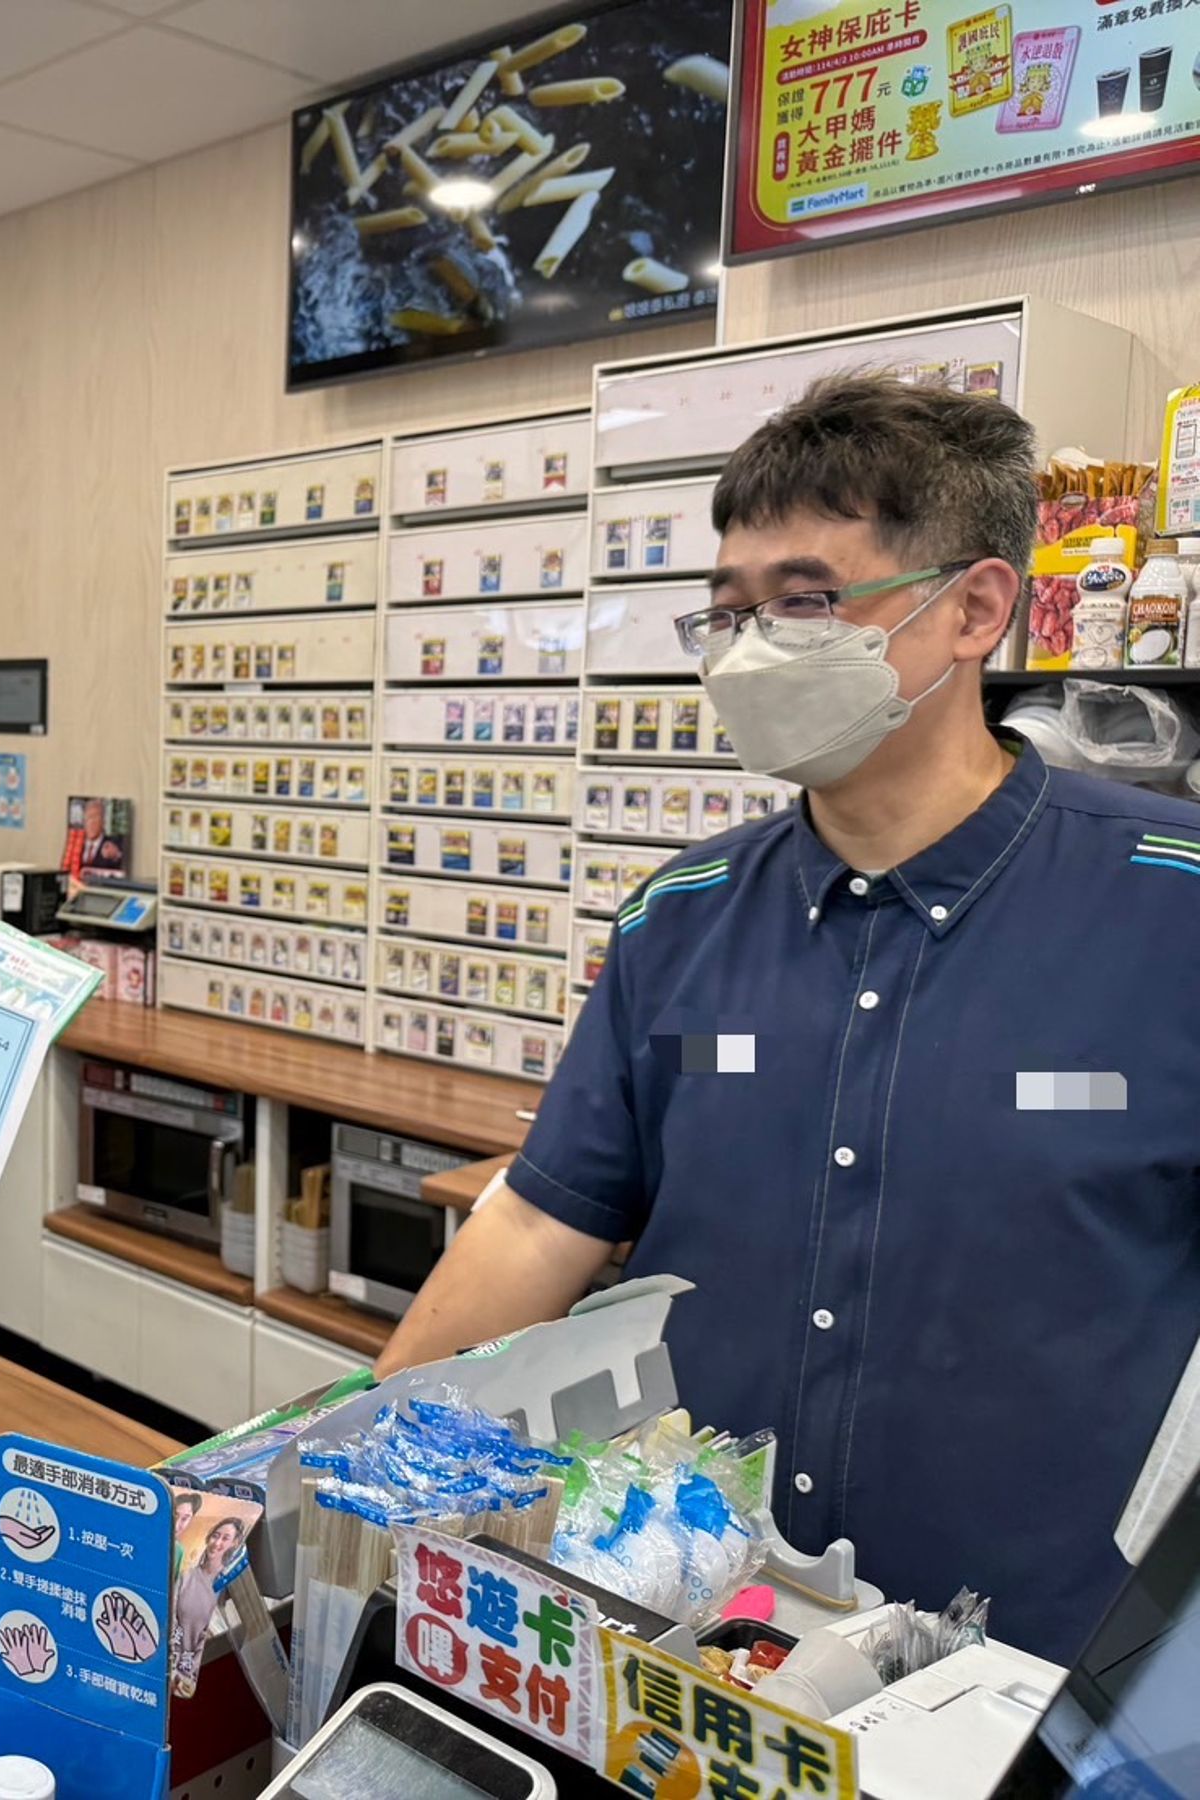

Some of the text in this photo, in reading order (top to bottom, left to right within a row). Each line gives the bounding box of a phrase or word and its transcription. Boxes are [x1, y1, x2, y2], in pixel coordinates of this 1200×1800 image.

[780, 0, 921, 62] 女神保庇卡
[810, 66, 879, 114] 777
[876, 82, 892, 97] 元
[798, 105, 877, 148] 大甲媽
[795, 129, 903, 177] 黃金擺件
[807, 187, 865, 209] FamilyMart
[12, 1453, 147, 1511] 最適手部消毒方式
[68, 1526, 135, 1560] 1.按壓一次
[60, 1601, 88, 1622] 消毒
[414, 1542, 576, 1668] 悠遊卡
[478, 1642, 571, 1737] 支付
[621, 1652, 832, 1793] 信用卡
